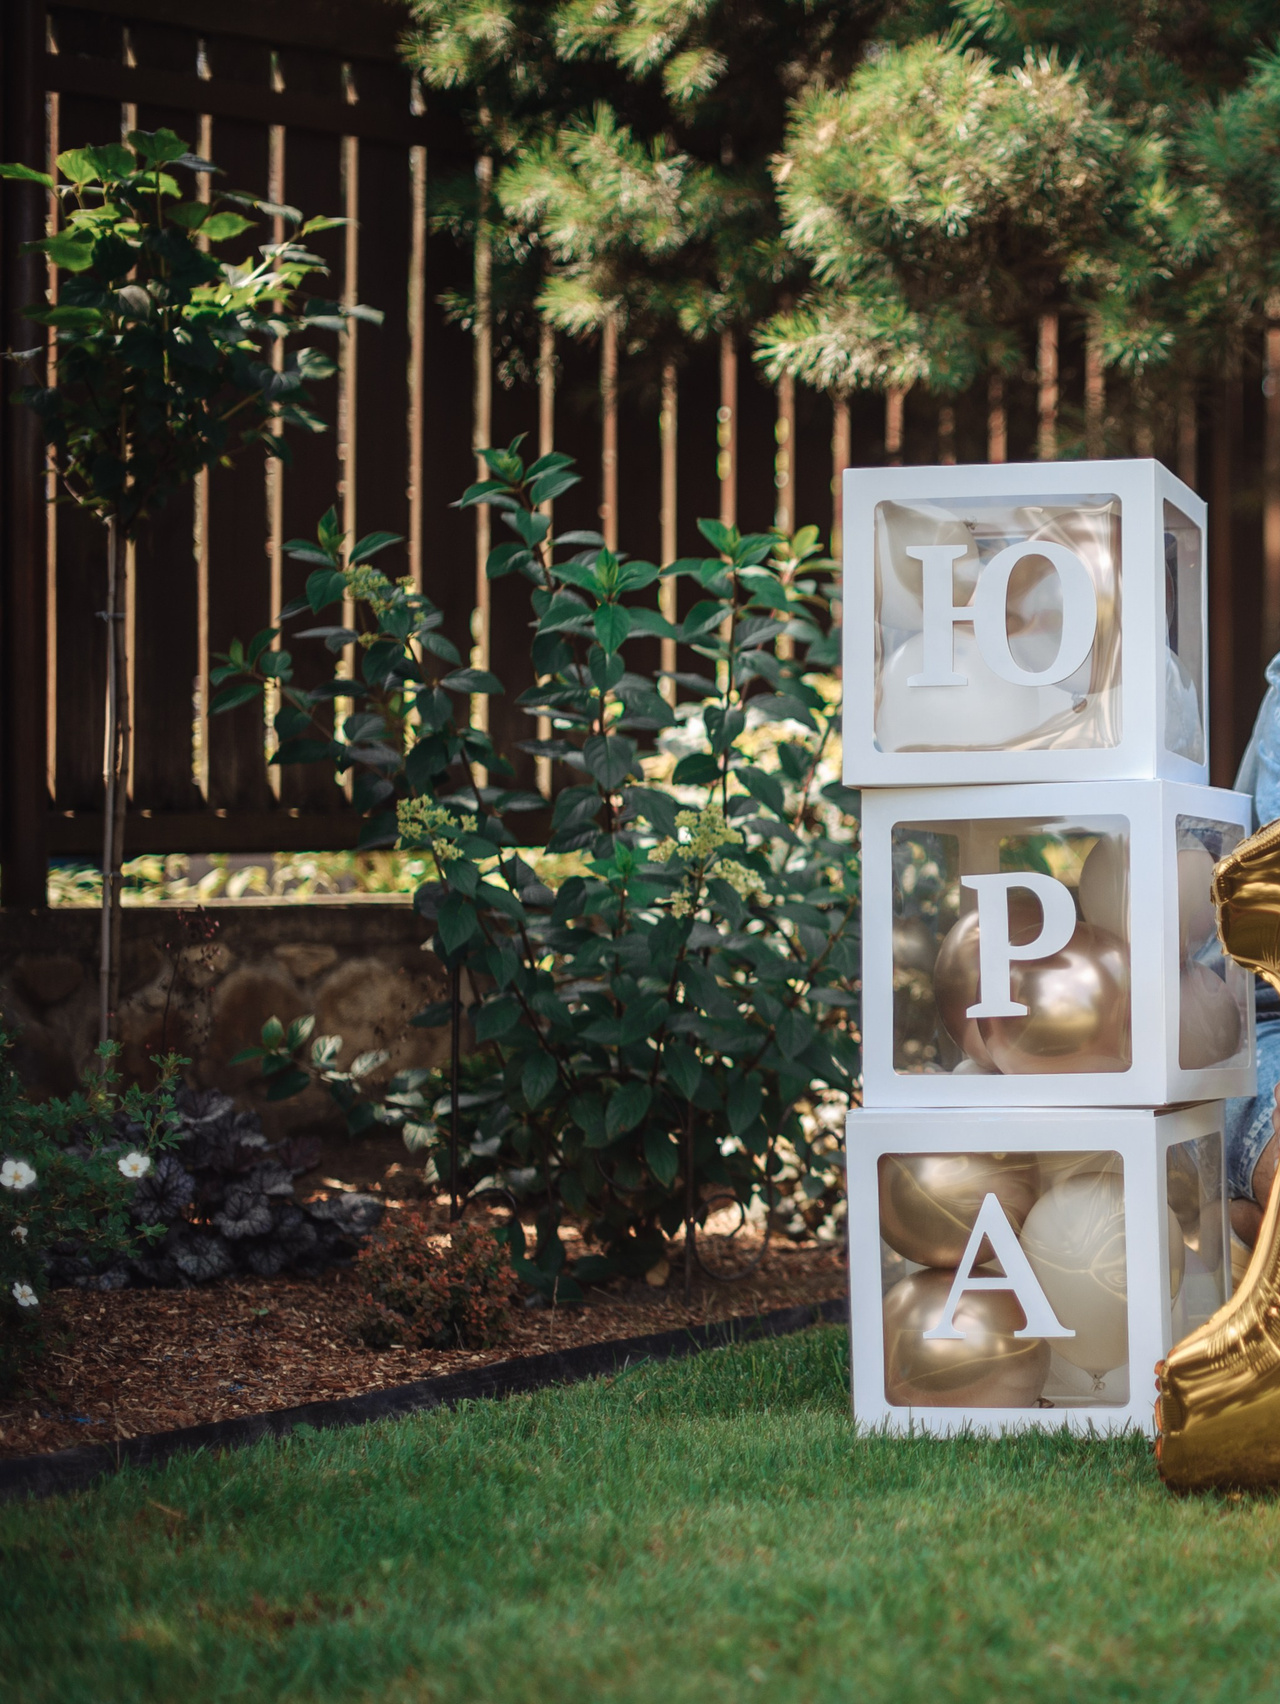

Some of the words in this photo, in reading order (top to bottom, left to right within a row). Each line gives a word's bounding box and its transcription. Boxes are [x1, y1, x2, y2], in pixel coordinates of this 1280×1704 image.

[906, 541, 1097, 687] Ю
[960, 872, 1077, 1018] Р
[923, 1192, 1076, 1340] А
